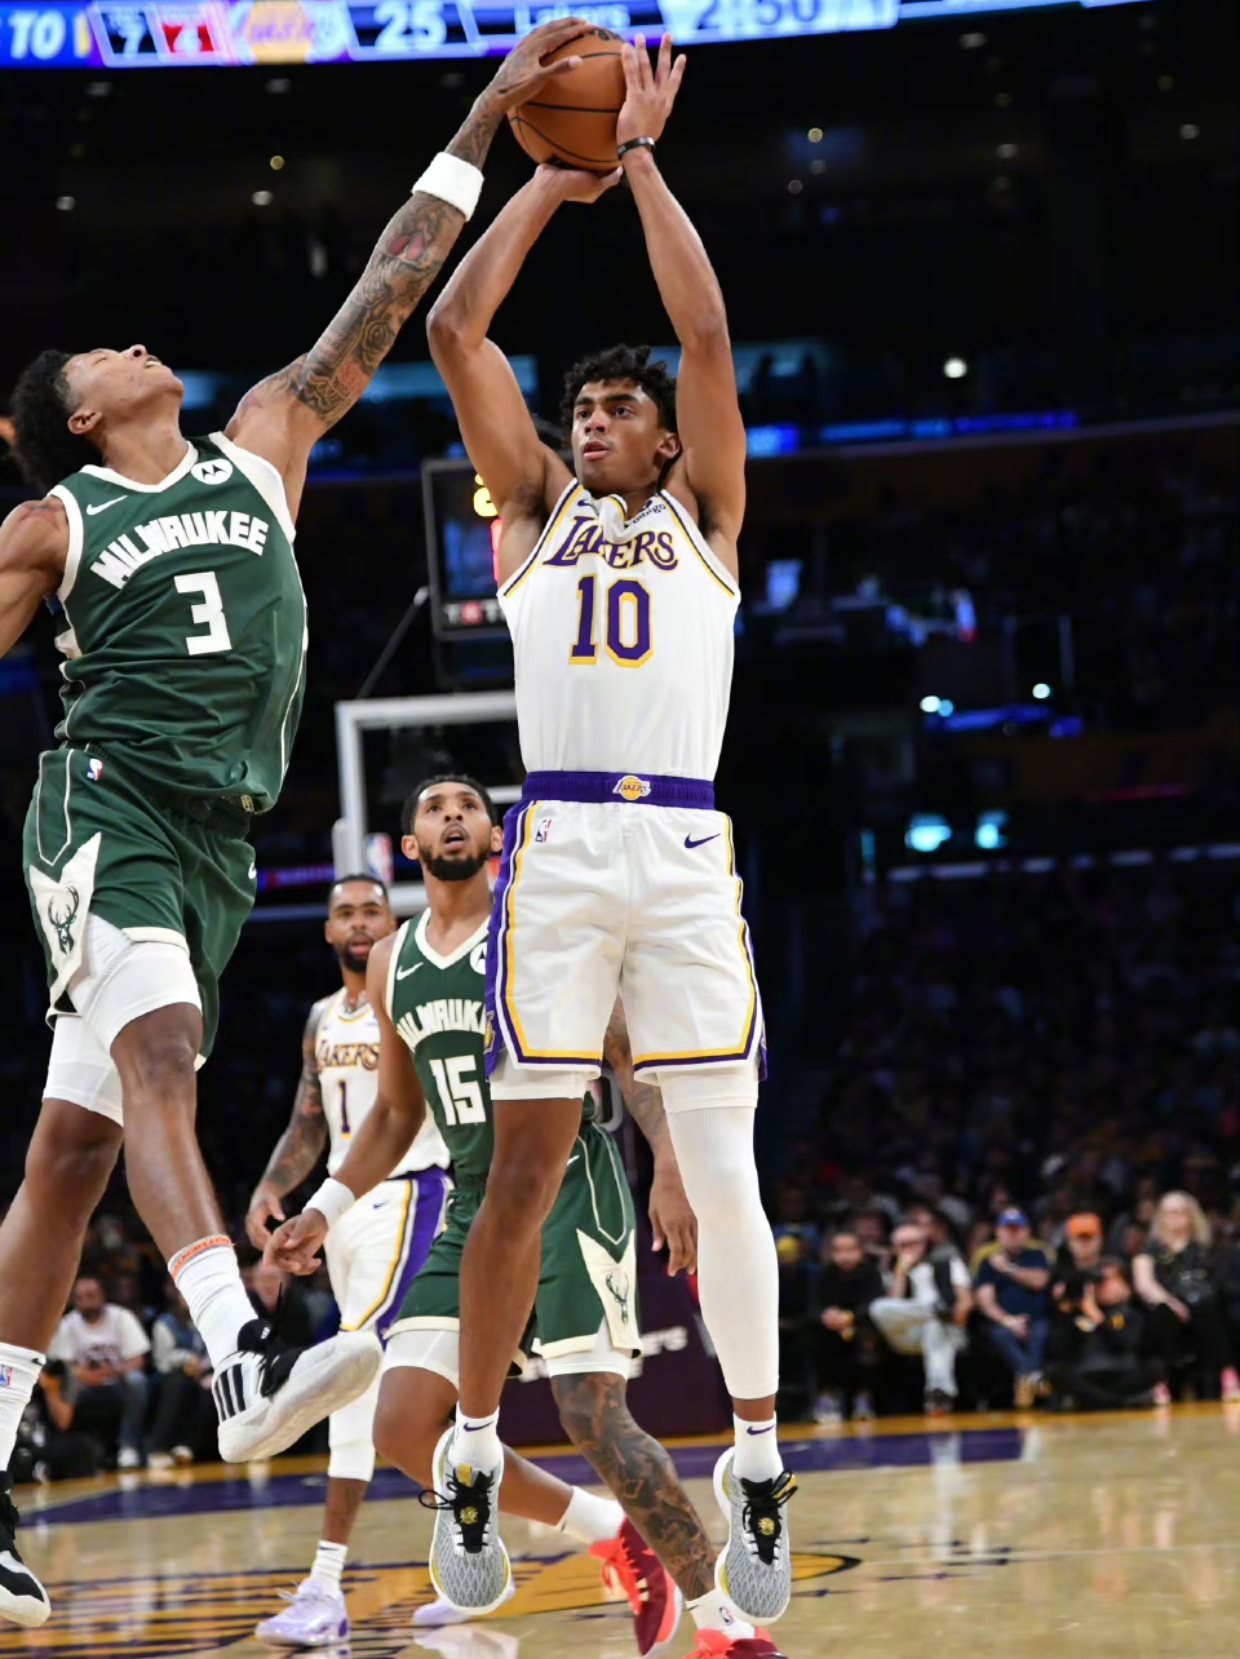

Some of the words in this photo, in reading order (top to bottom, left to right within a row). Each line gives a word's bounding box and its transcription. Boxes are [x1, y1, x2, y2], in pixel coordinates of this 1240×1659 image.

[373, 1, 448, 51] 25
[90, 510, 270, 590] MILWAUKEE
[541, 515, 680, 573] LAKERS
[173, 570, 233, 656] 3
[568, 573, 654, 668] 10
[396, 999, 487, 1053] ILWAUK
[337, 1078, 352, 1139] 1
[429, 1054, 487, 1126] 15
